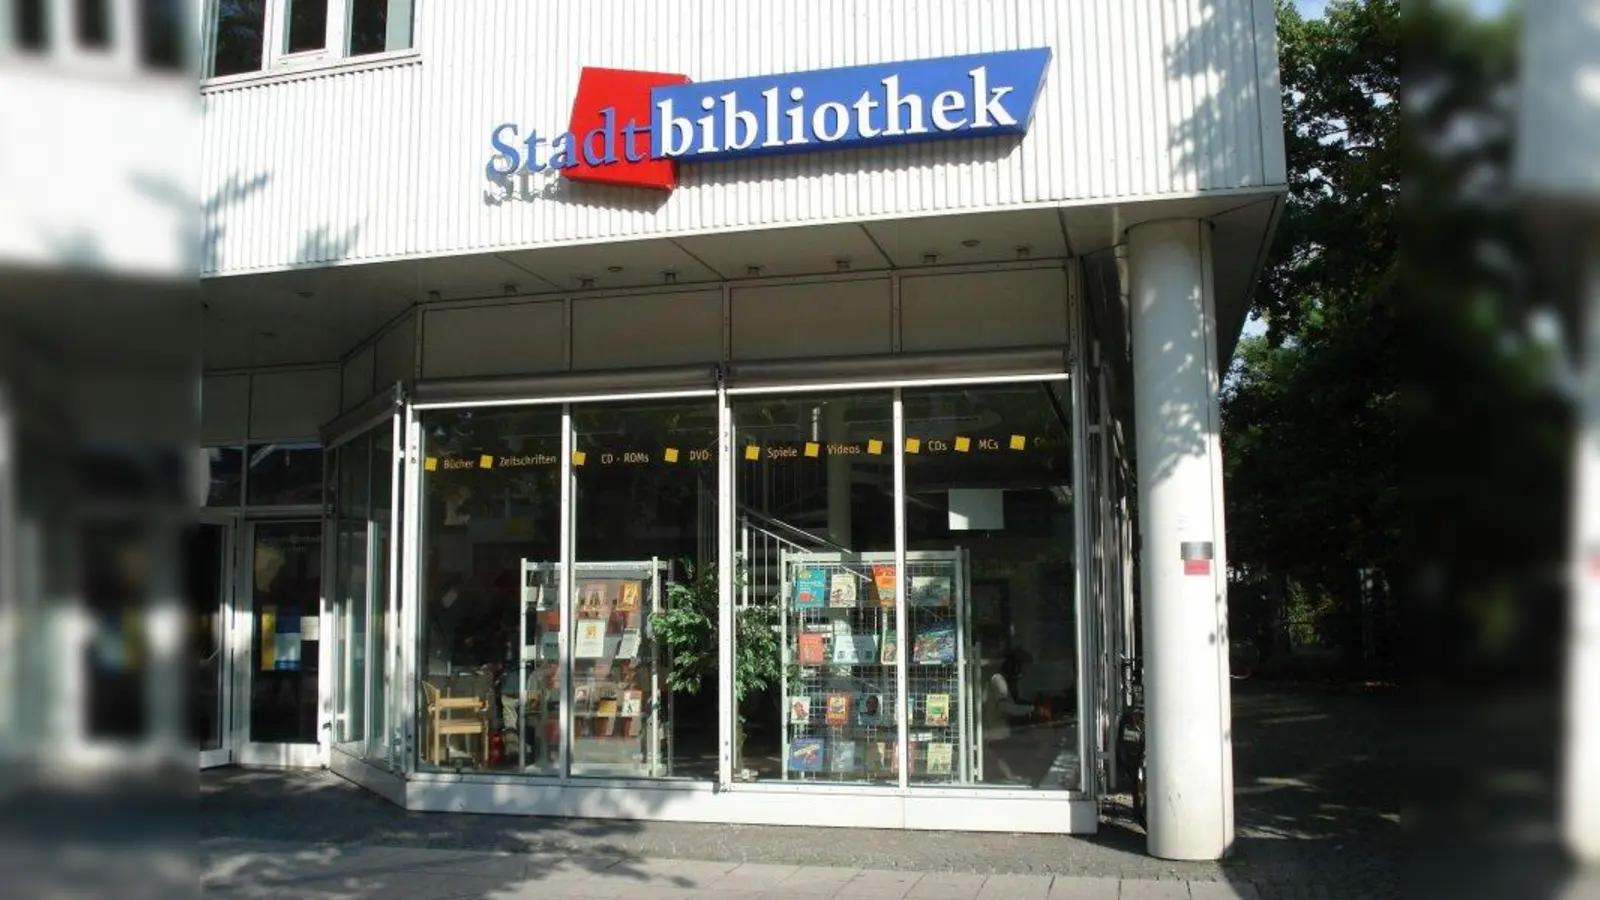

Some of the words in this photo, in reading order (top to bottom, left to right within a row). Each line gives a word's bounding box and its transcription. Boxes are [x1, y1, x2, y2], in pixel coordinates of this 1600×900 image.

[767, 446, 798, 459] Spiele
[826, 444, 861, 455] Videos
[928, 440, 947, 452] CDs
[979, 439, 999, 450] MCs
[443, 458, 475, 469] Bücher
[499, 454, 557, 467] Zeitschriften
[624, 452, 649, 463] ROMs
